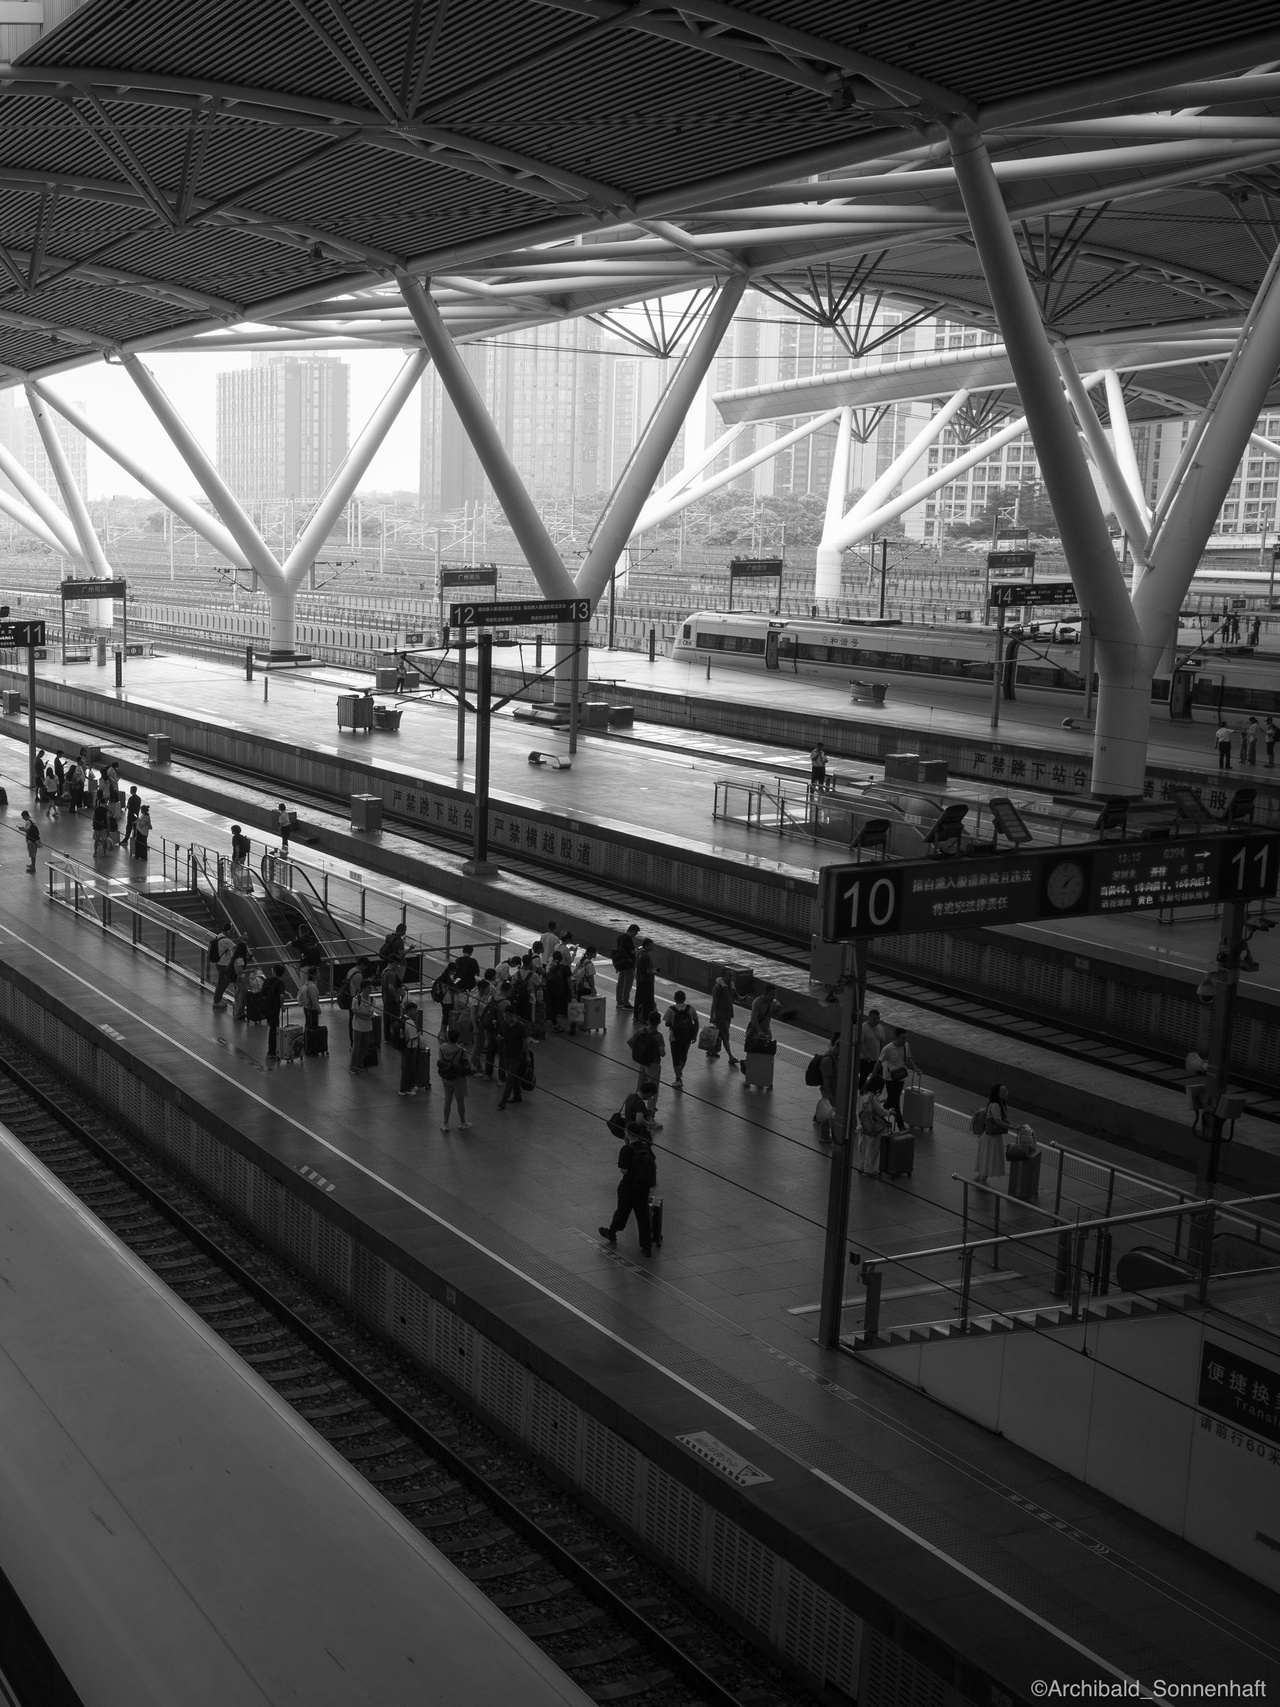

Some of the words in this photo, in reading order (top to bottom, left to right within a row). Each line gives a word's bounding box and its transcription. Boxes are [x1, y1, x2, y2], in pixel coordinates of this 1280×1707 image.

[995, 587, 1013, 604] 14
[454, 606, 475, 625] 12
[569, 602, 589, 620] 13
[23, 624, 41, 644] 11
[829, 636, 859, 648] 和谐号
[973, 752, 1087, 788] 严禁跳下站台
[392, 789, 473, 831] 严禁跳下站台
[493, 817, 591, 866] 严禁横越股道
[1118, 852, 1142, 863] 13:15
[1231, 844, 1269, 891] 11
[843, 877, 895, 928] 10
[932, 896, 1009, 917] 将追究法律责任
[1138, 895, 1154, 906] 黄色
[1233, 1395, 1280, 1428] Transf
